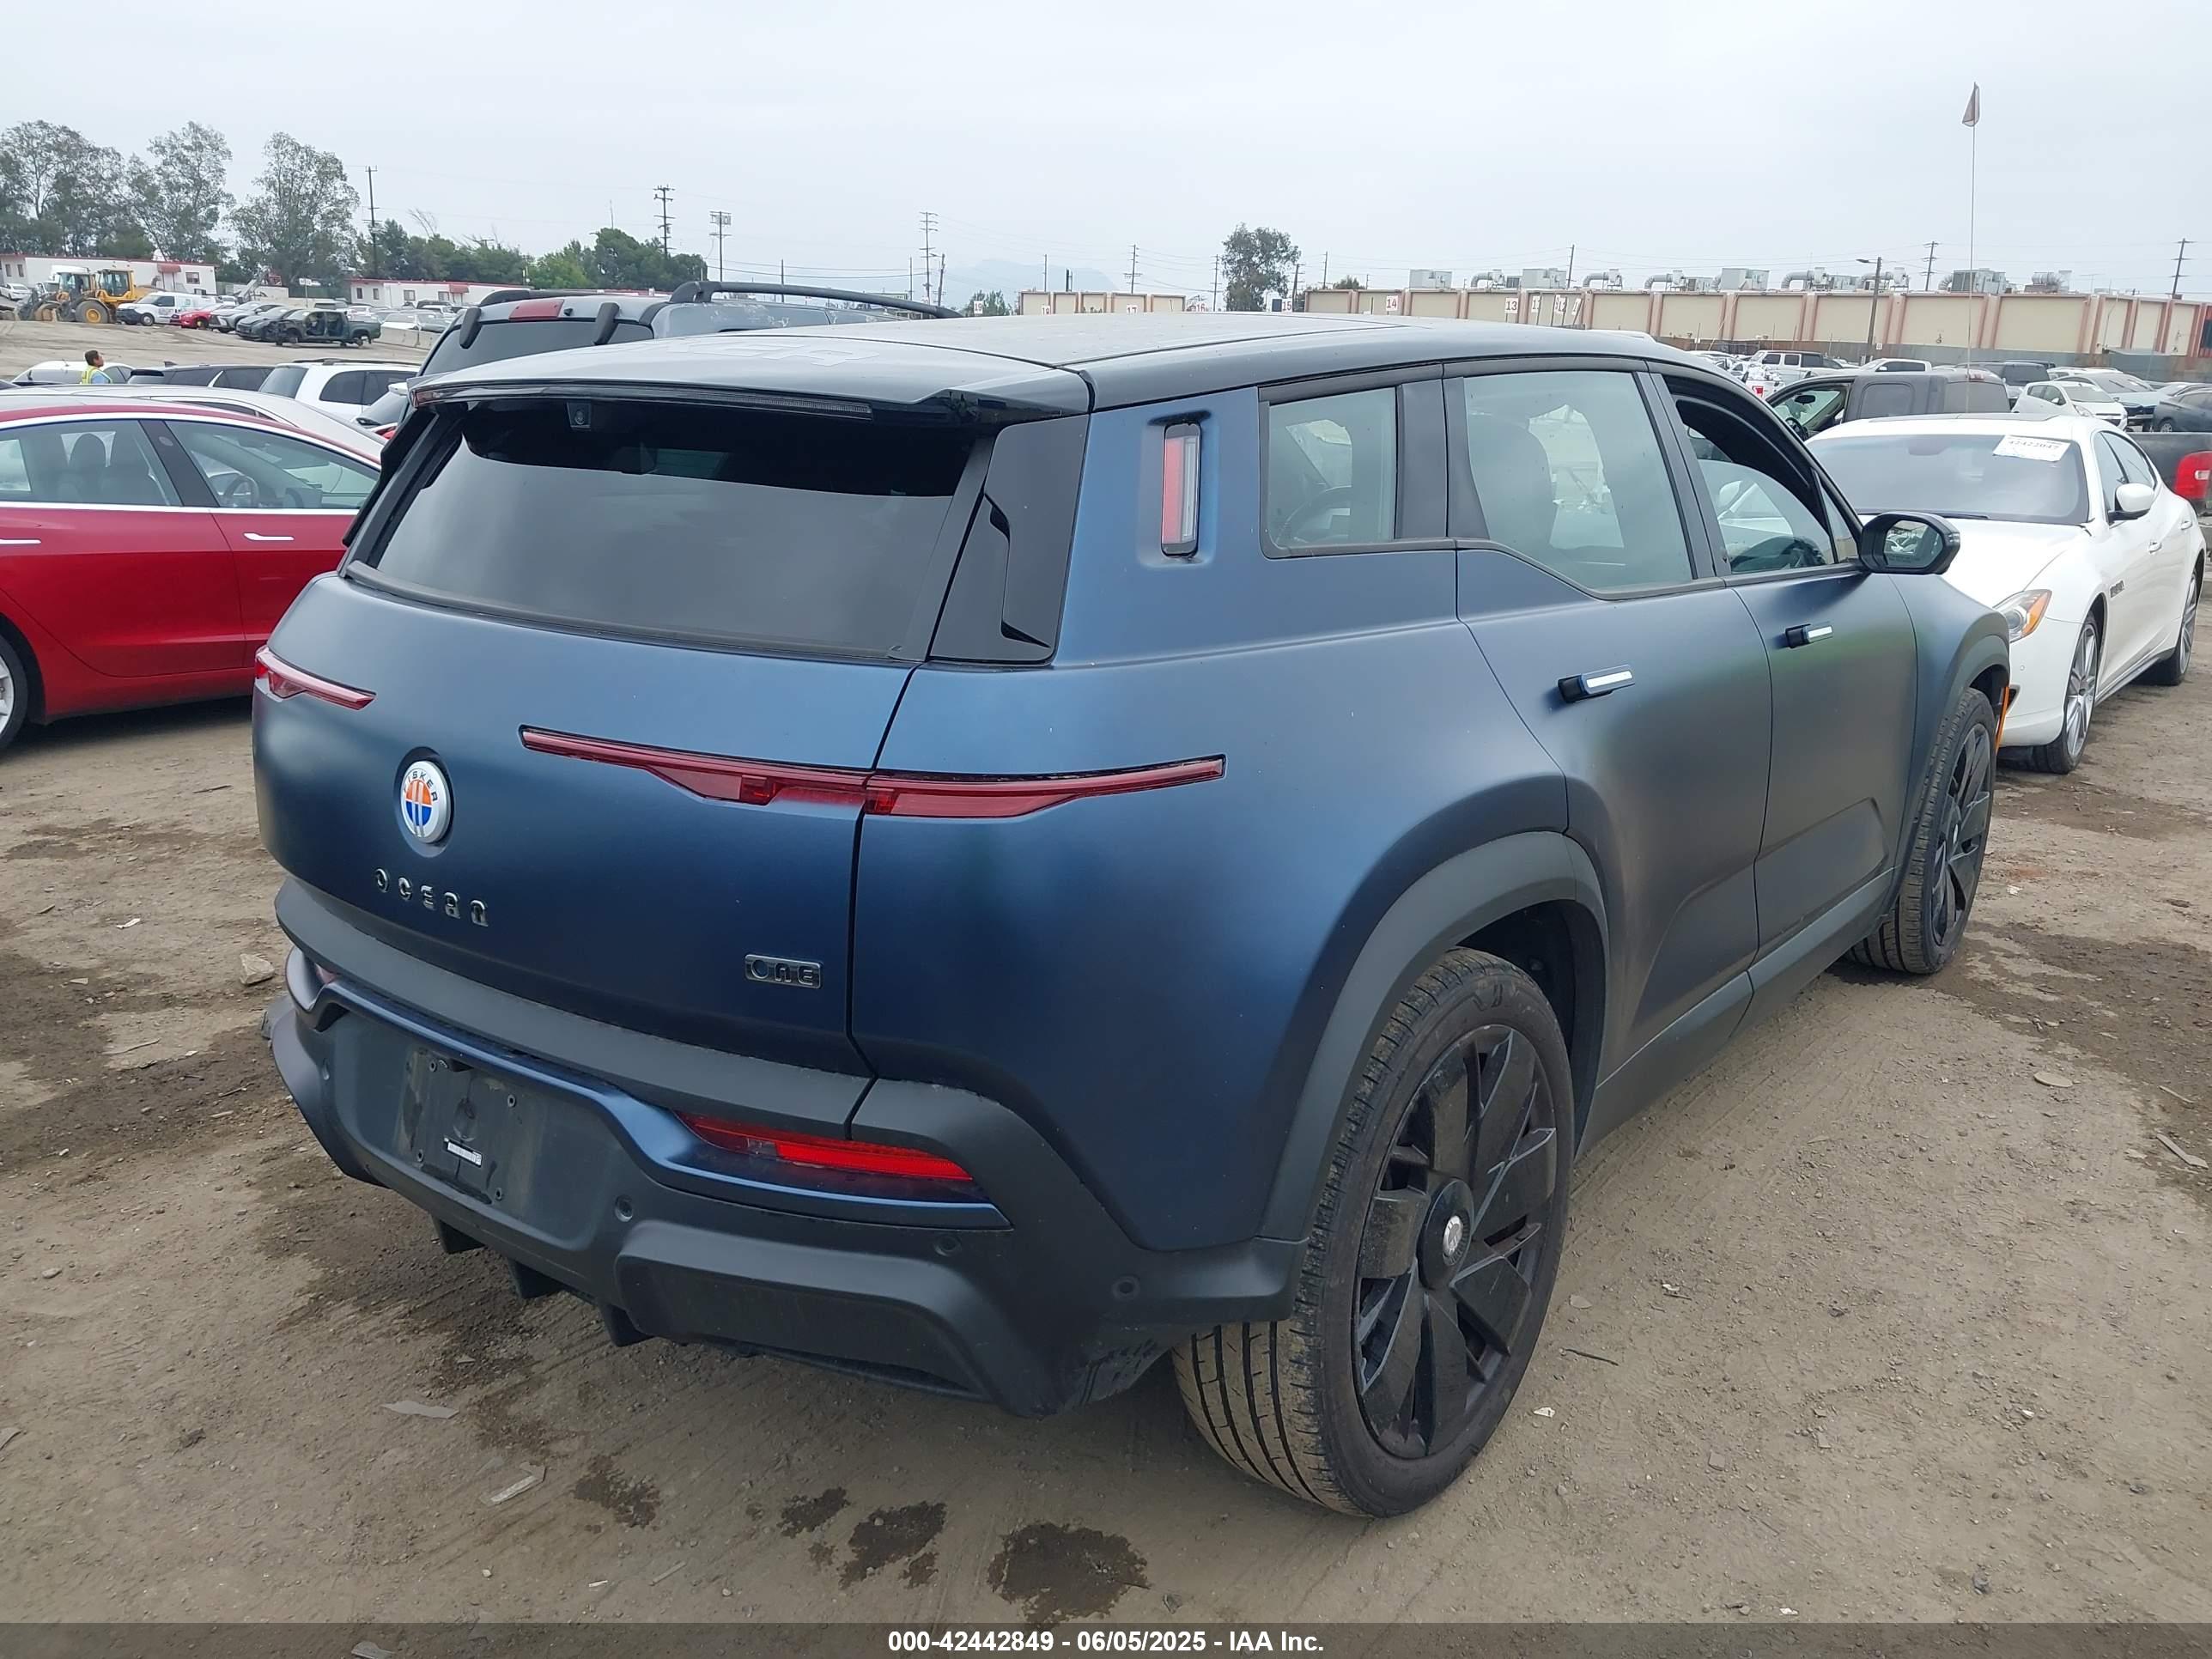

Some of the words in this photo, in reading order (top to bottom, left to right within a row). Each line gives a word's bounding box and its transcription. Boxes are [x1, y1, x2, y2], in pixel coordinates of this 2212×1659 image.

[1282, 301, 1291, 310] 15
[1386, 298, 1397, 308] 14
[1505, 301, 1517, 310] 13
[374, 868, 488, 927] OCEAN
